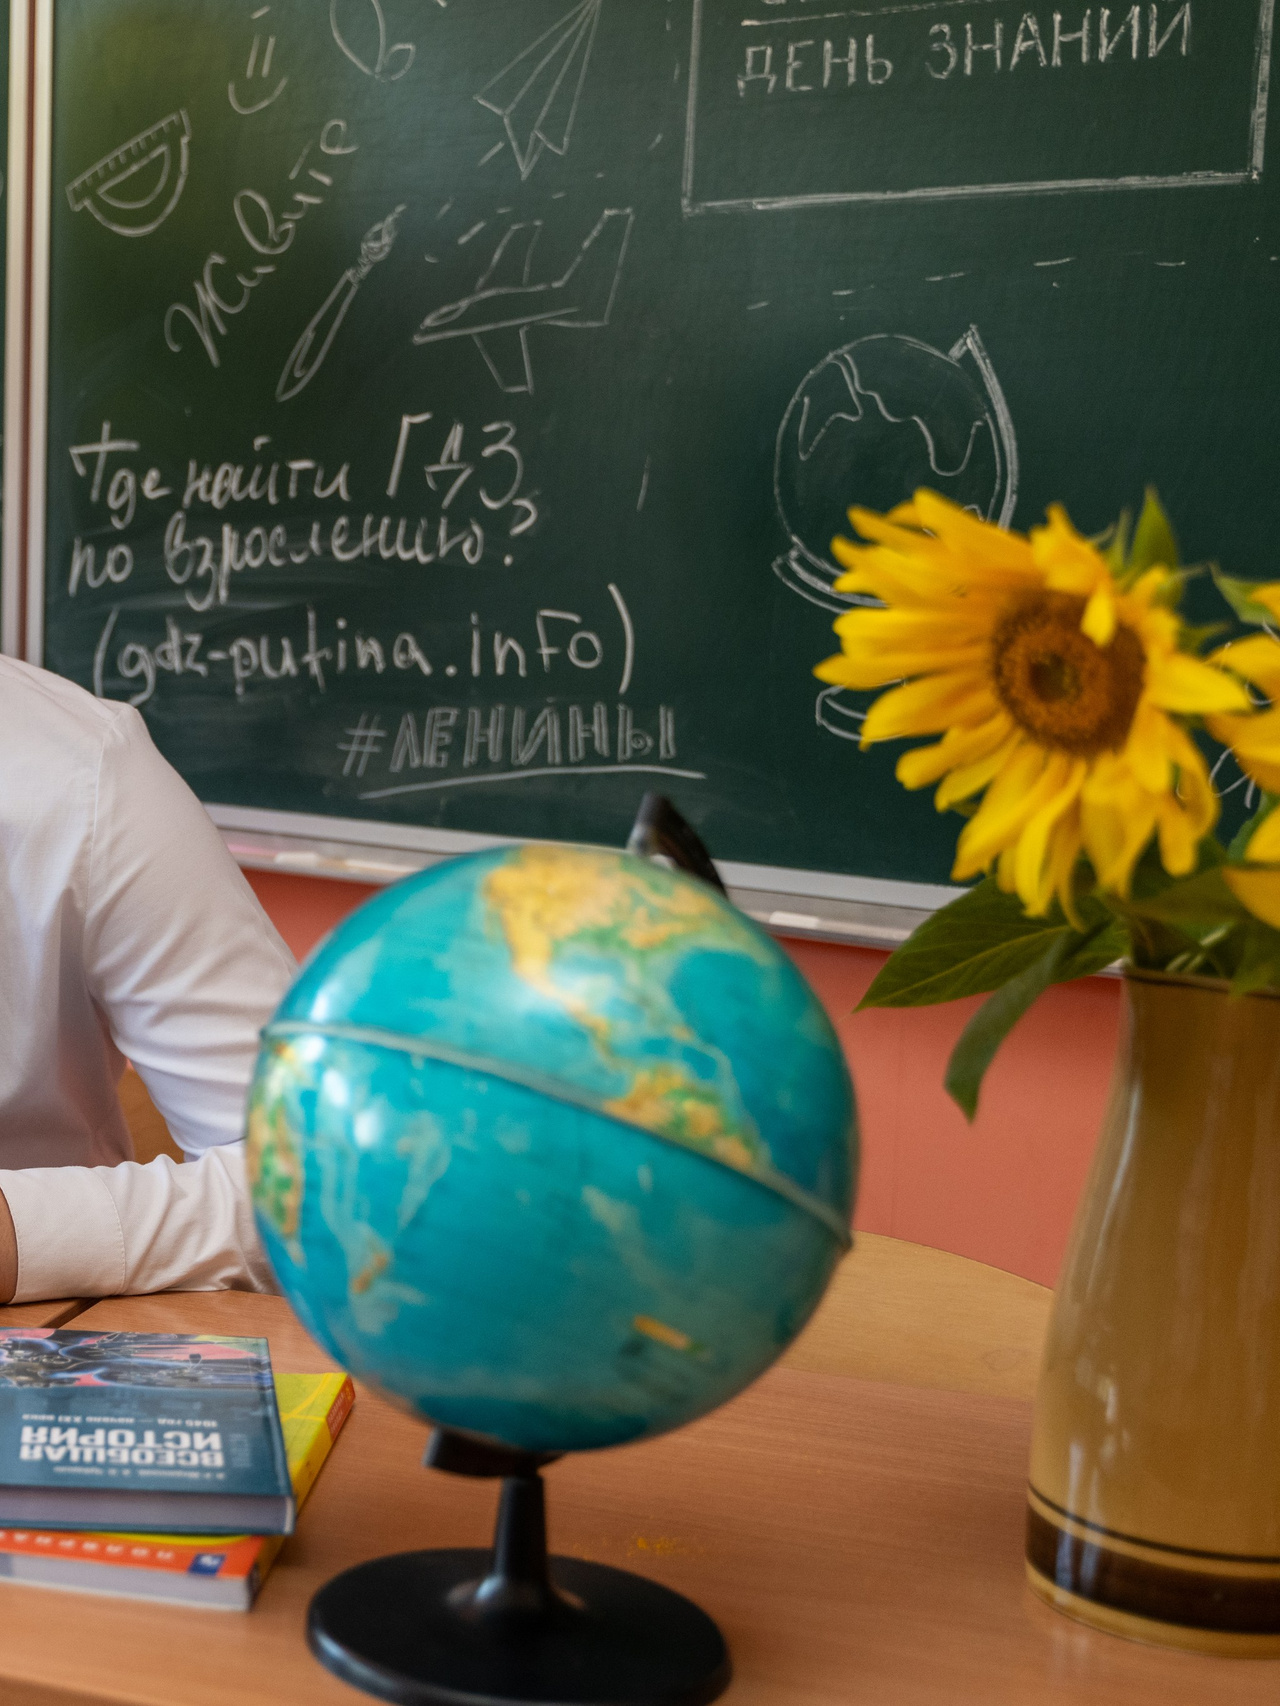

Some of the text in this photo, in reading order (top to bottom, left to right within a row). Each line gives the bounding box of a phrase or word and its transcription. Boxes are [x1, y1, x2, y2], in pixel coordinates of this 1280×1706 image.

[737, 34, 894, 98] ДЕНЬ
[164, 119, 360, 368] Живите
[183, 434, 351, 510] найти
[386, 413, 525, 511] ГДЗ
[68, 537, 134, 598] по
[19, 1426, 223, 1452] ИСТОРИЯ
[19, 1443, 225, 1469] ВСЕОБЩАЯ
